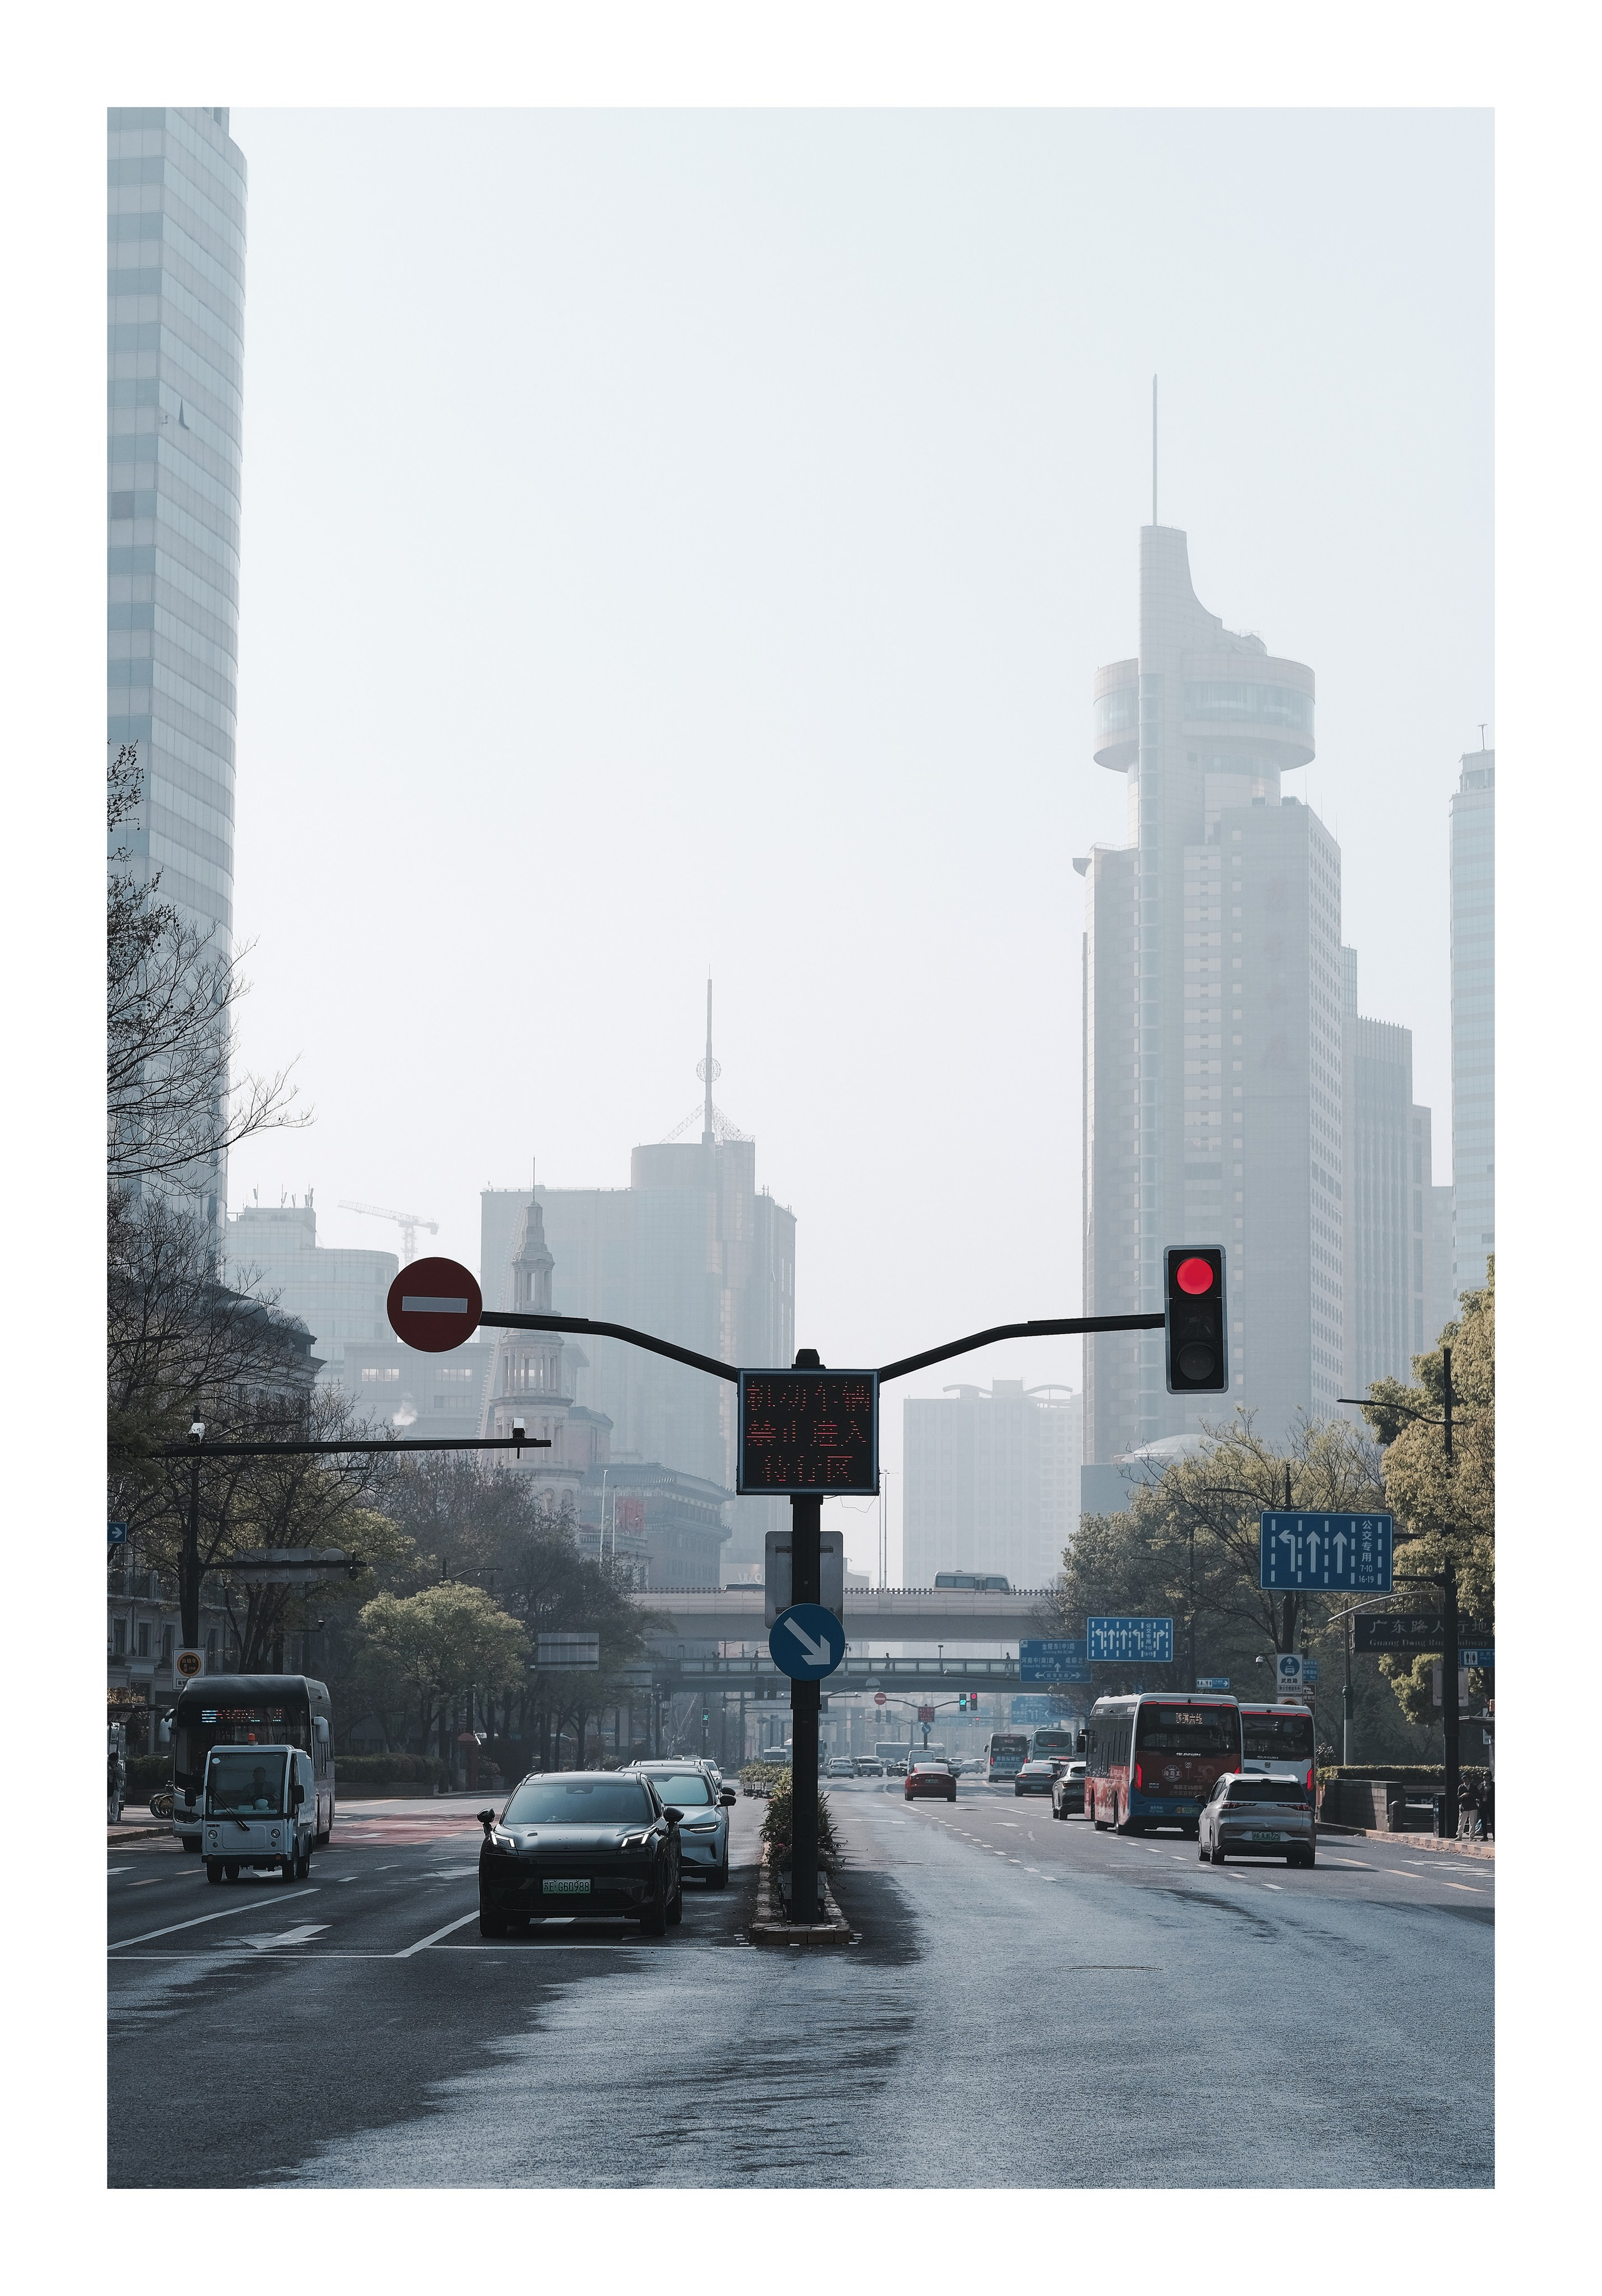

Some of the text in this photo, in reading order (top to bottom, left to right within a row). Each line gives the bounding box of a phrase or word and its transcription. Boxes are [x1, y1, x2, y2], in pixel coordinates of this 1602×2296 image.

[747, 1381, 870, 1411] 机动车辆
[747, 1420, 867, 1446] 禁止进入
[1361, 1520, 1373, 1563] 公交专用
[1369, 1639, 1399, 1647] Guang
[1402, 1639, 1426, 1647] Dong
[1459, 1639, 1489, 1647] ubway
